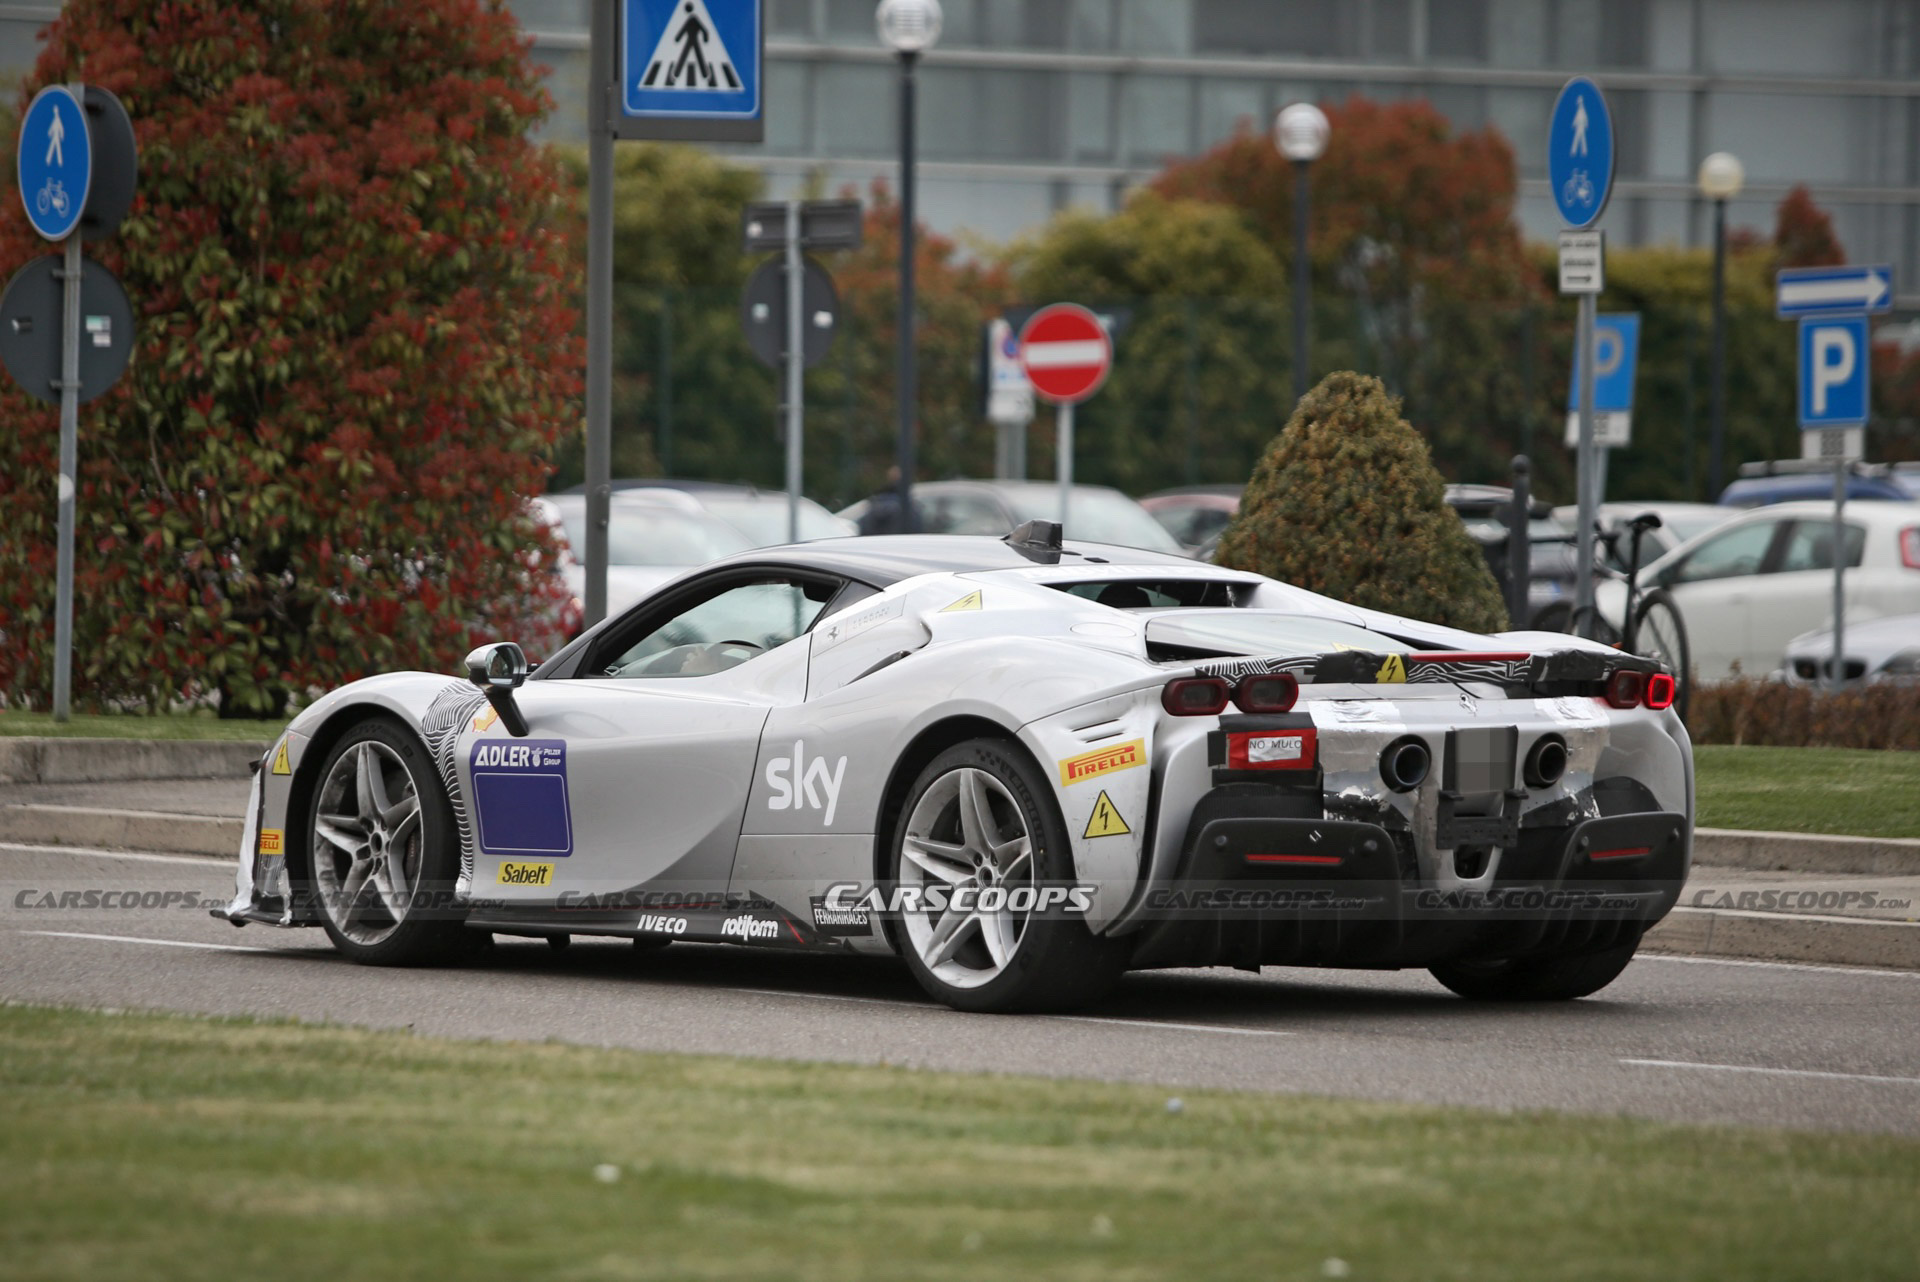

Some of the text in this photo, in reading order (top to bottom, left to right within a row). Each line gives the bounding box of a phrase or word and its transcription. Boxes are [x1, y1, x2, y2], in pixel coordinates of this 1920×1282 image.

[1812, 326, 1856, 417] P
[474, 745, 530, 767] ADLER
[1249, 740, 1266, 750] NO
[543, 757, 561, 766] GROUP
[1067, 745, 1136, 780] PIRELLI
[766, 739, 847, 826] sky
[501, 863, 548, 885] Sabelt
[636, 914, 688, 934] IVECO
[720, 914, 779, 941] rotiform
